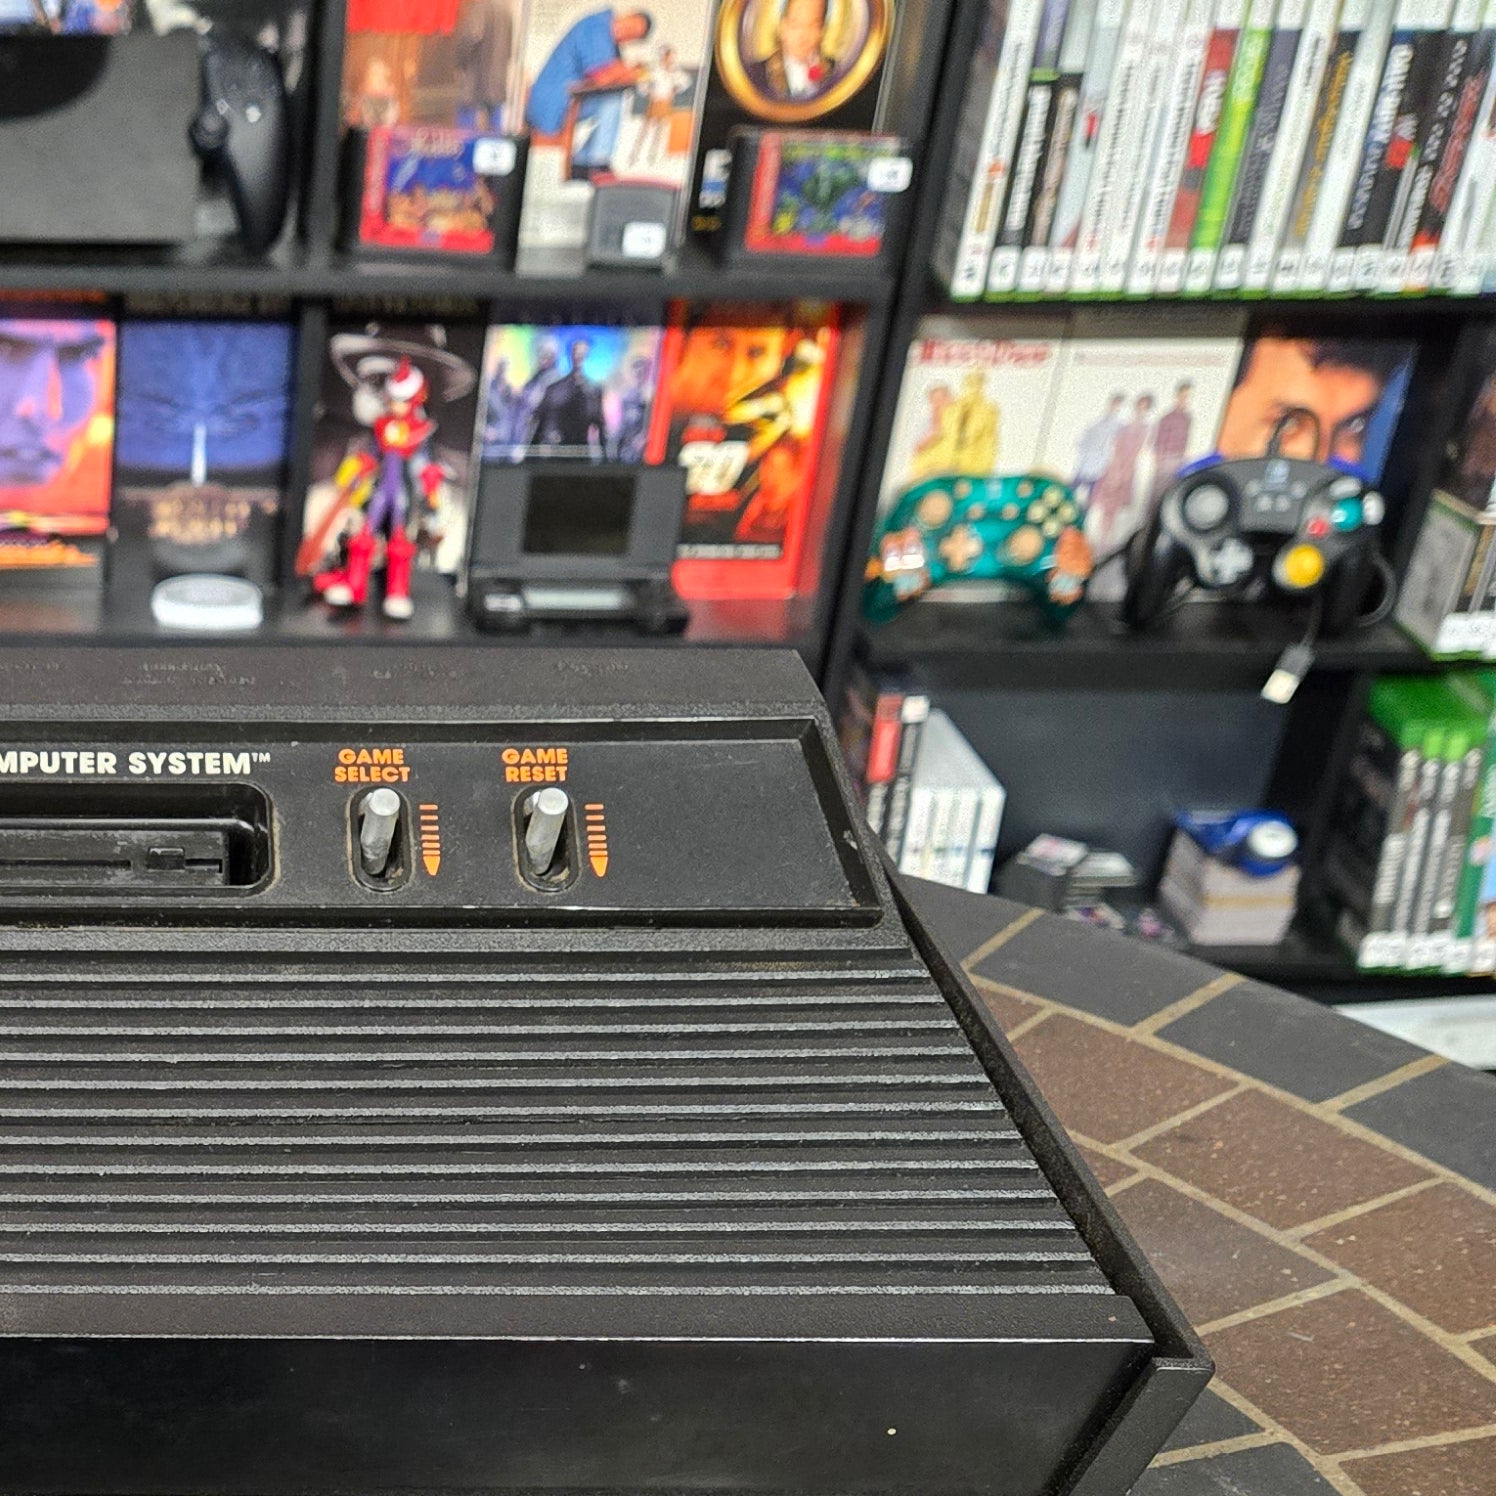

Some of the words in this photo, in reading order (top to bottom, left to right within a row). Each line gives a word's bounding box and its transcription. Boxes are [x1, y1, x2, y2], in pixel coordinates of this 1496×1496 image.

[338, 749, 404, 764] GAME
[502, 748, 568, 764] GAME
[334, 767, 410, 782] SELECT
[506, 766, 567, 782] RESET
